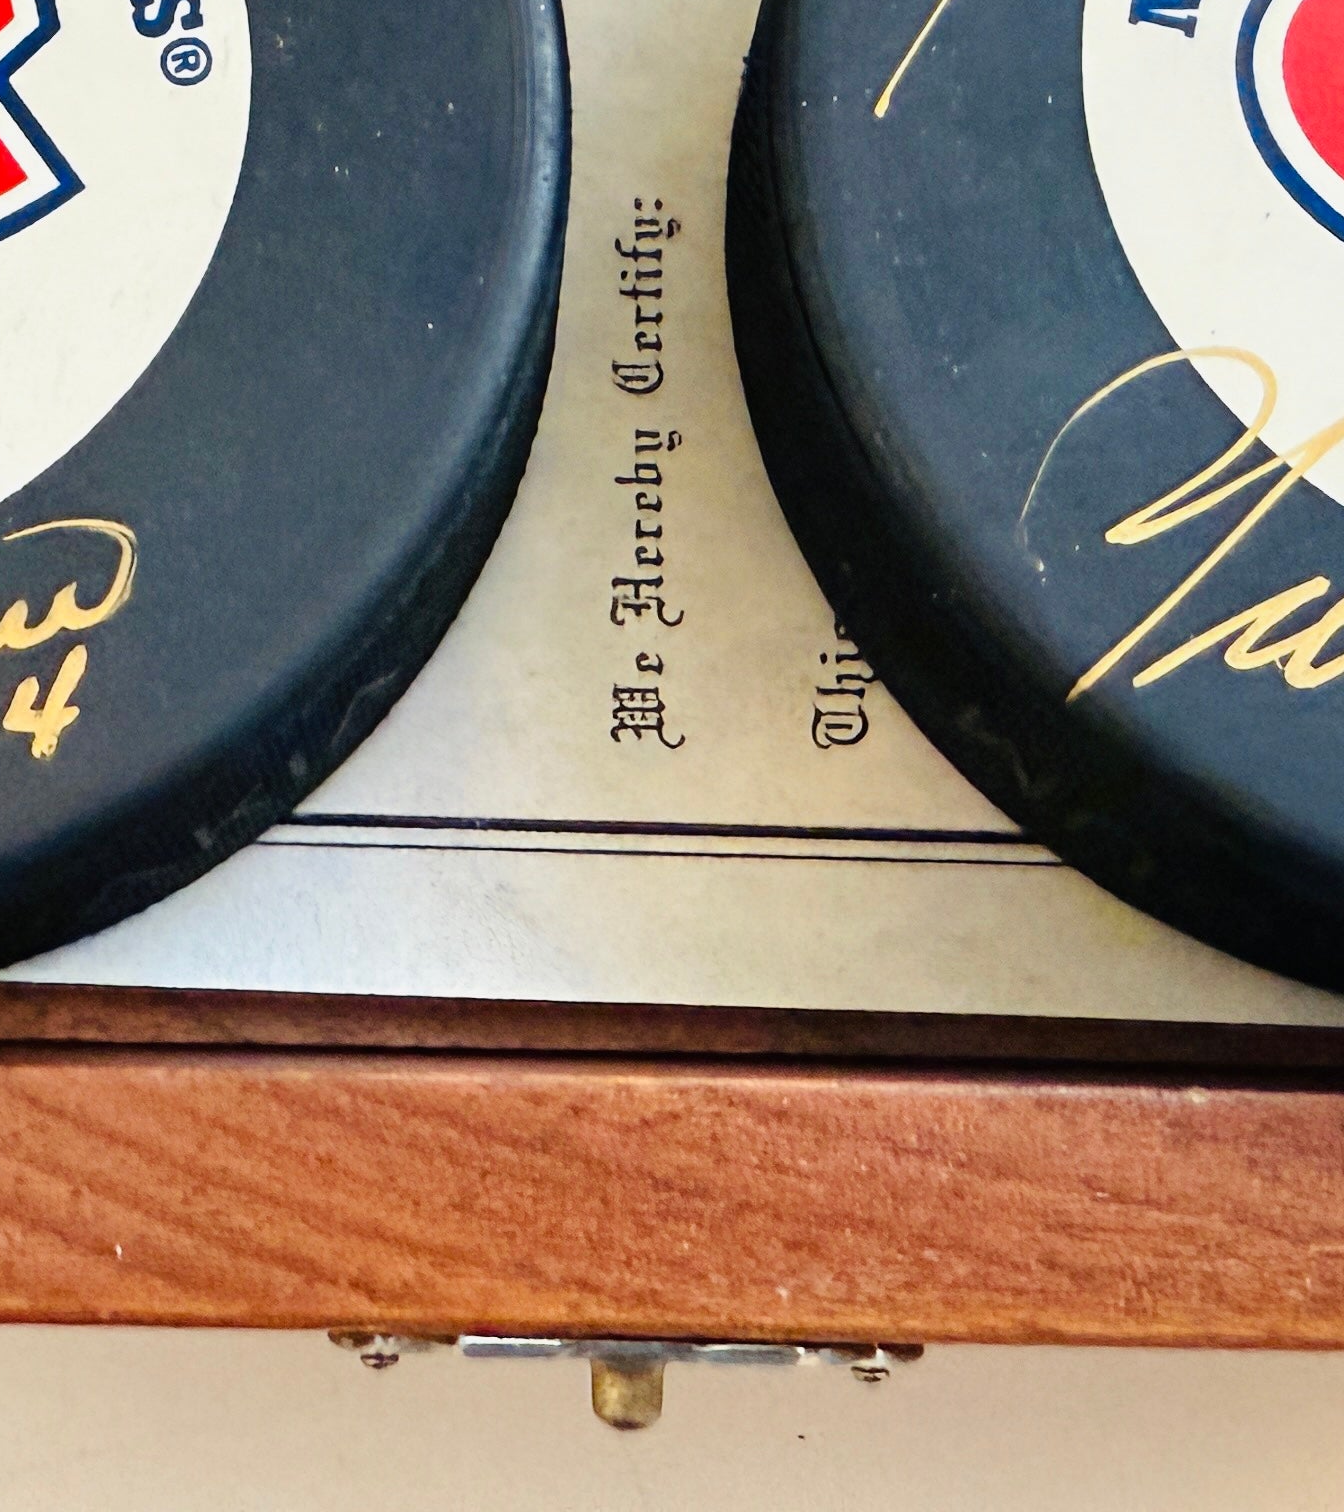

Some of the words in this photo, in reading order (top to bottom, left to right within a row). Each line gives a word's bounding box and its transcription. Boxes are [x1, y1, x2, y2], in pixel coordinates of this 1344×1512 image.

[610, 196, 682, 395] Certify:
[609, 428, 686, 627] Hereby
[609, 650, 686, 750] We
